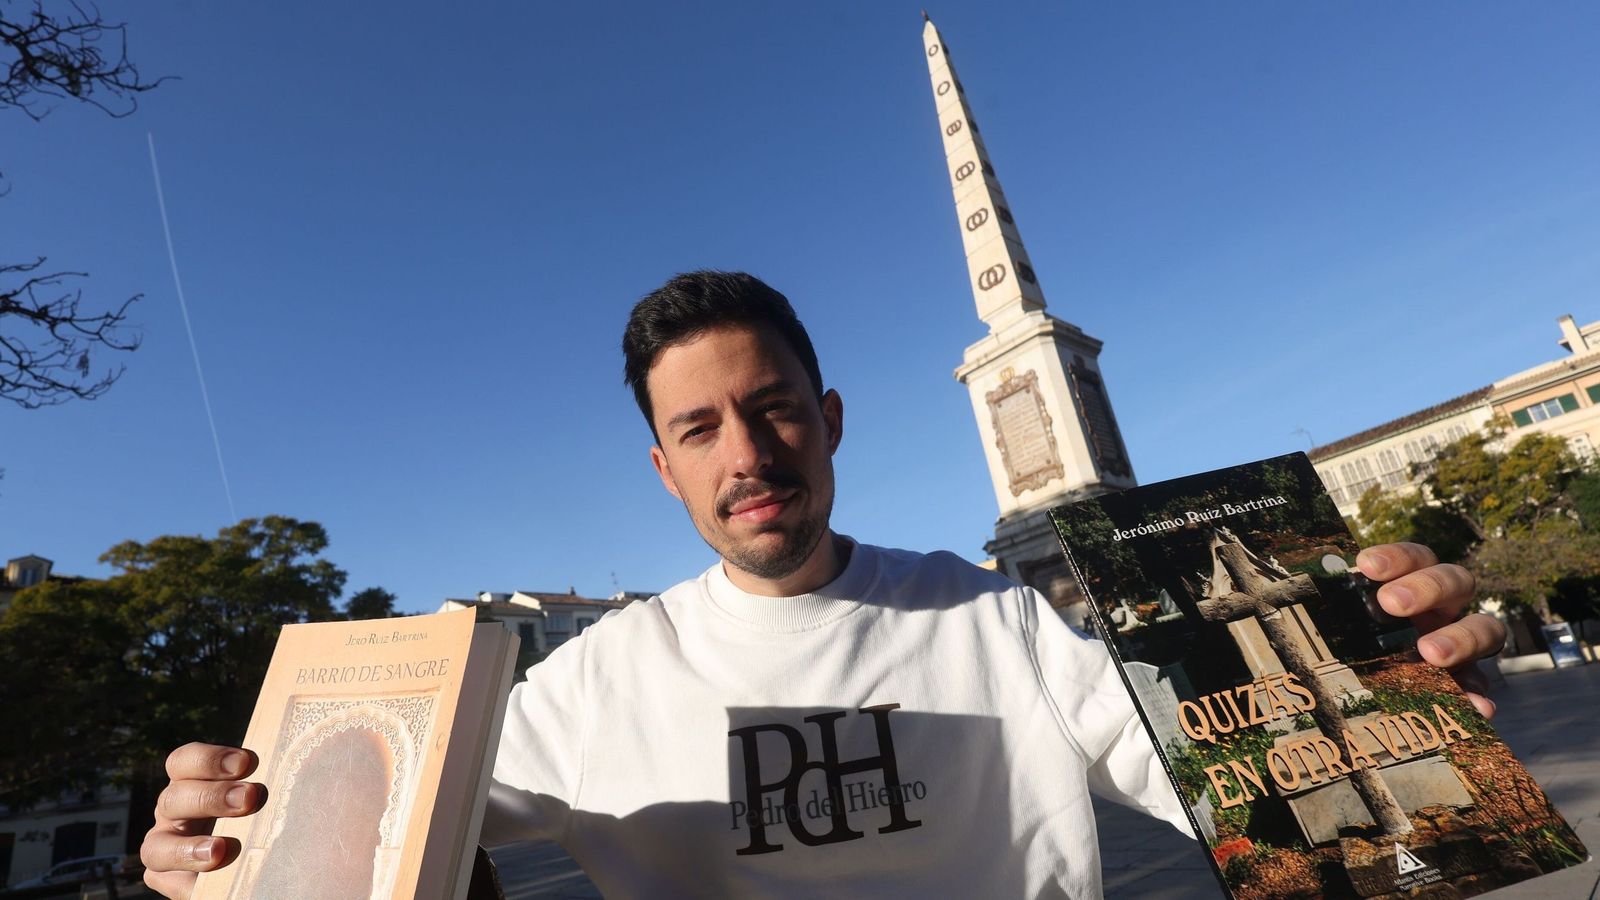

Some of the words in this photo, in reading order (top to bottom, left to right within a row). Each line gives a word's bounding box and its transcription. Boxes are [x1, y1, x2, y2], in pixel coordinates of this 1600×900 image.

[1112, 516, 1185, 542] Jerónimo
[1185, 508, 1223, 524] Ruiz
[1222, 495, 1288, 517] Bartrina
[296, 666, 356, 685] BARRIO
[358, 664, 383, 683] DE
[384, 658, 450, 681] SANGRE
[1203, 755, 1270, 809] EN
[1266, 728, 1379, 792] OTRA
[1364, 703, 1473, 761] VIDA
[729, 796, 801, 831] Pedro
[805, 787, 842, 820] del
[844, 778, 928, 813] Hierro
